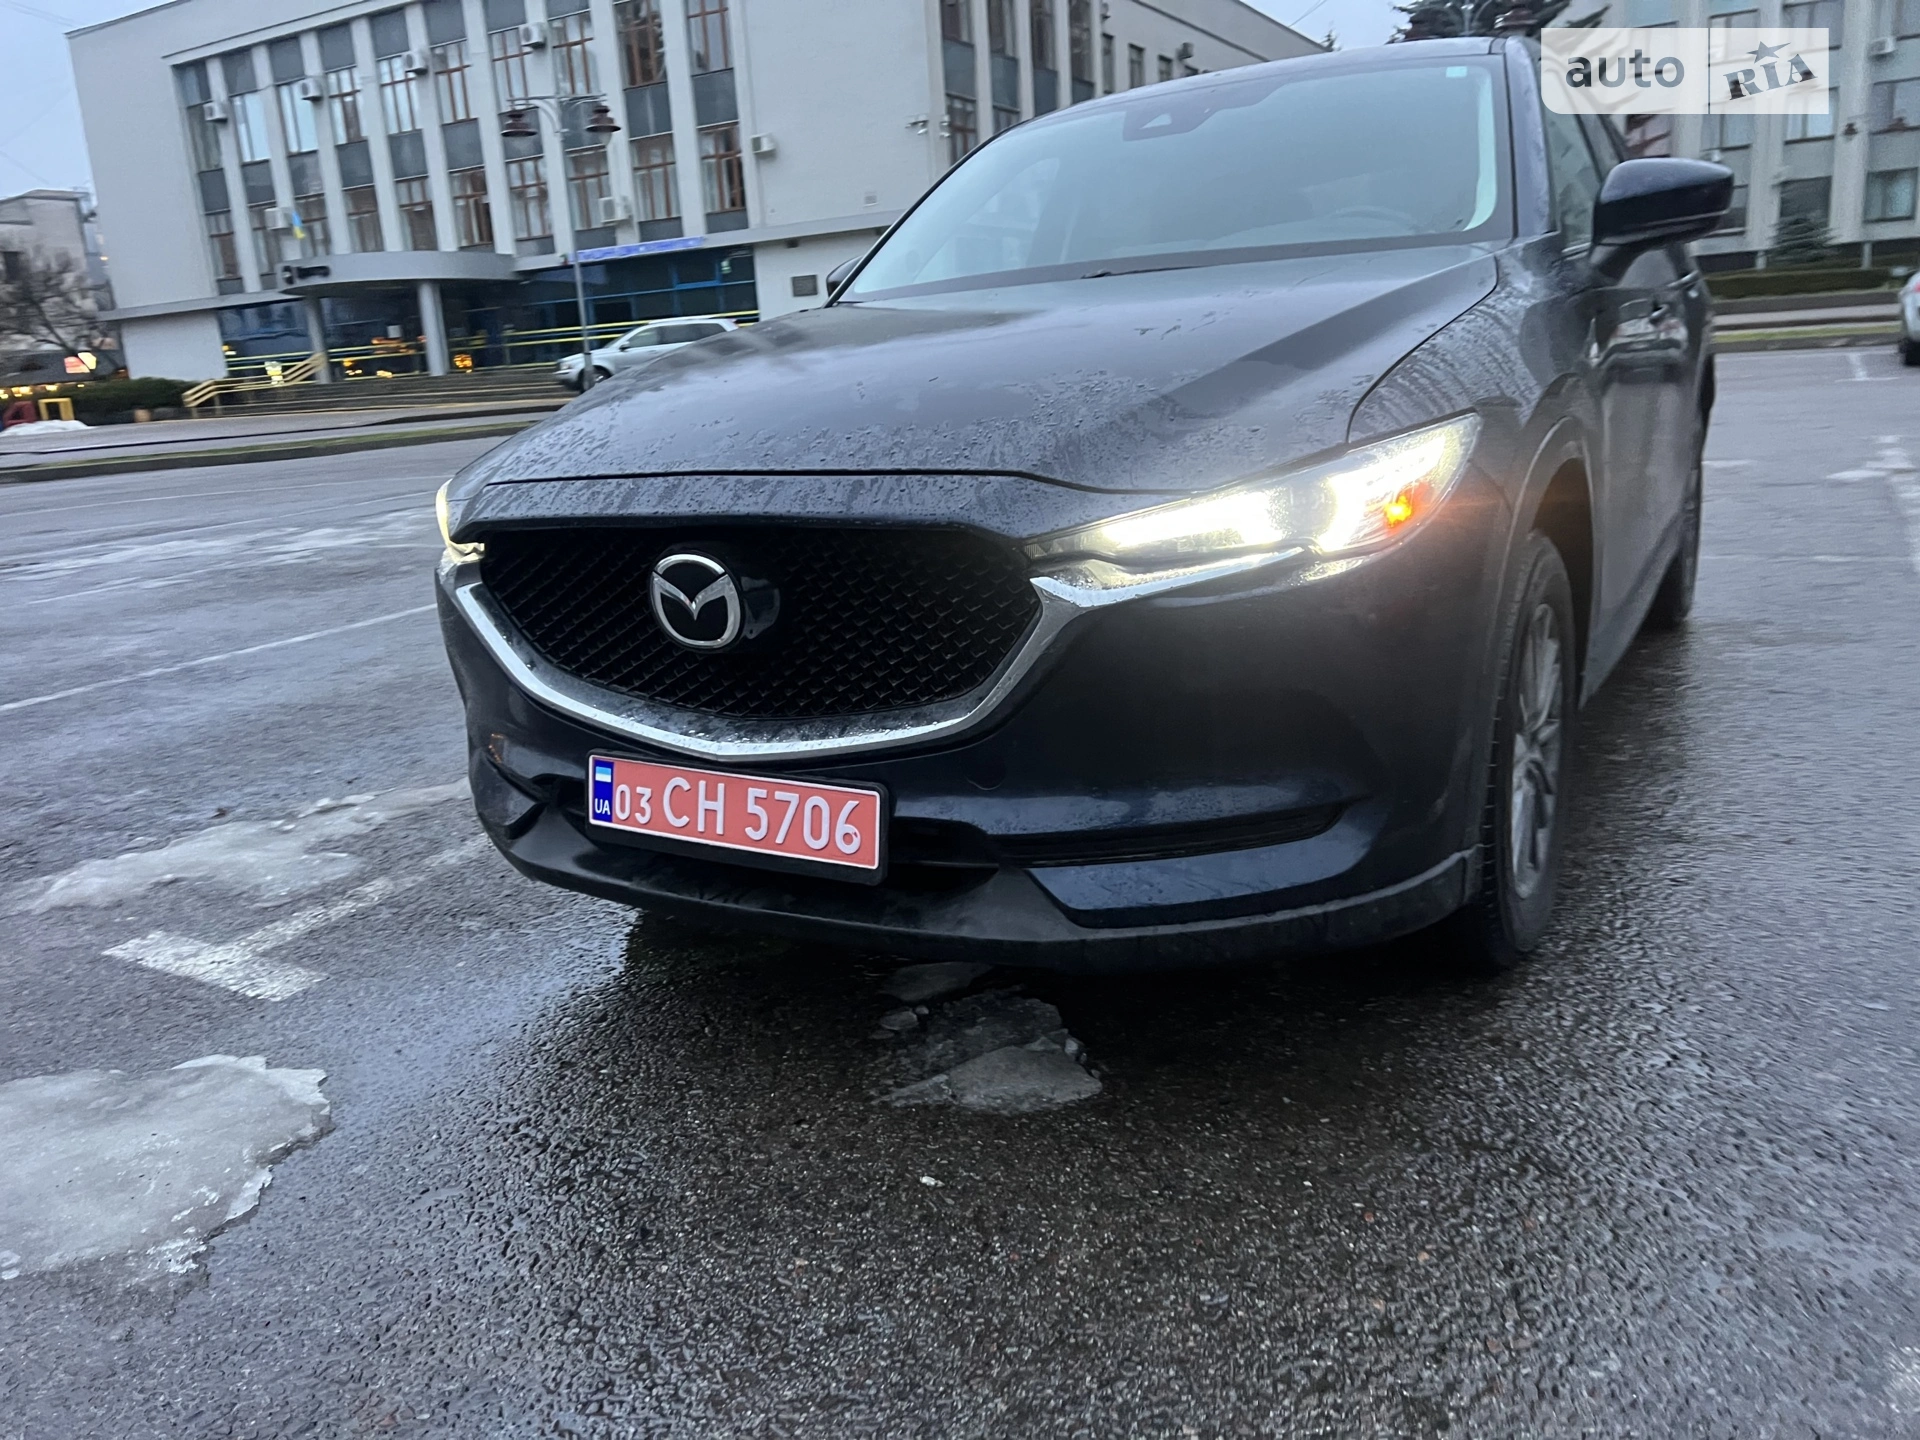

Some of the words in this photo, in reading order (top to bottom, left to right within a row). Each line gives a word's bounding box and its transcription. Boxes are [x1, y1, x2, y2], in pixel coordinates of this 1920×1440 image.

[594, 797, 611, 816] UA
[614, 783, 652, 825] 03
[662, 776, 725, 836] CH
[744, 786, 861, 855] 5706
